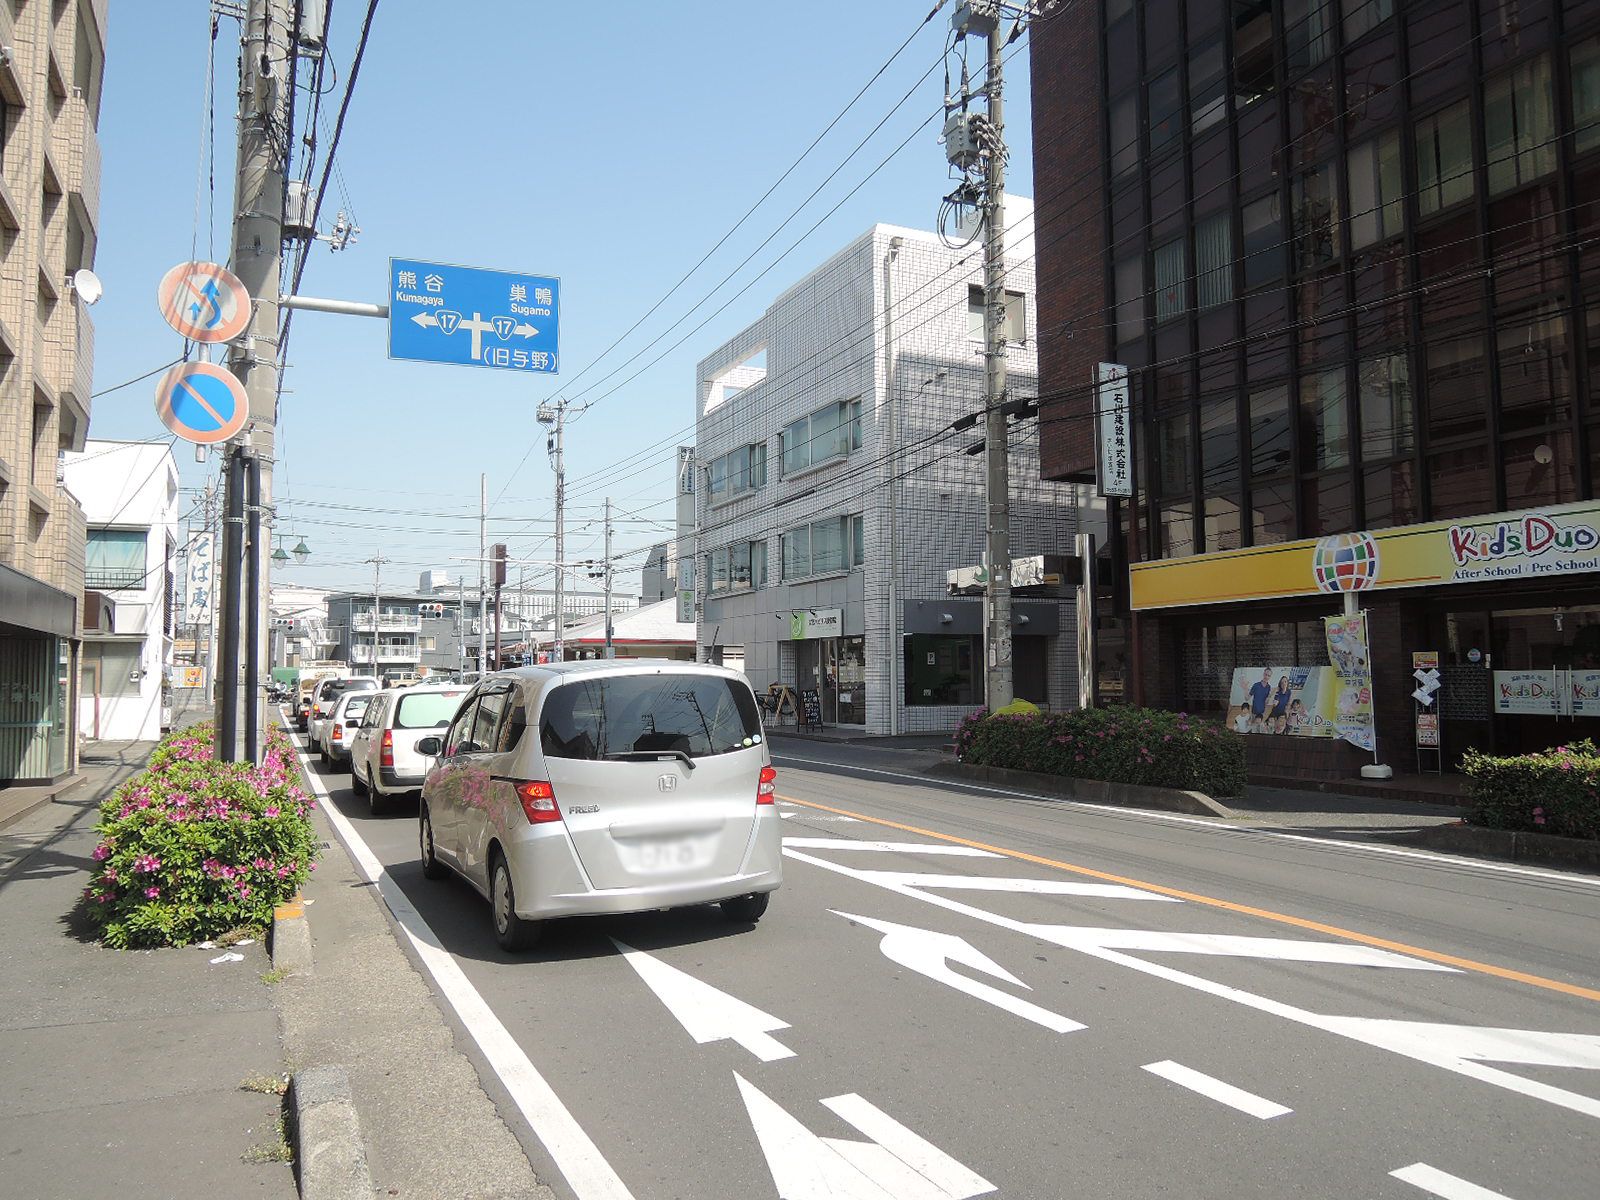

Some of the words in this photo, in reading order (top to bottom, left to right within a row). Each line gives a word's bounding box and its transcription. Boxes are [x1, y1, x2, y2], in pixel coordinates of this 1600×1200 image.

[398, 270, 444, 293] 熊谷
[396, 291, 444, 306] Kumagaya
[509, 284, 552, 306] 巣鴨
[510, 303, 551, 317] Sugamo
[441, 314, 456, 329] 17
[497, 320, 511, 334] 17
[1452, 569, 1481, 580] After
[1484, 564, 1522, 577] School
[1531, 562, 1552, 573] Pre
[1555, 557, 1598, 571] School
[569, 804, 600, 814] FREED
